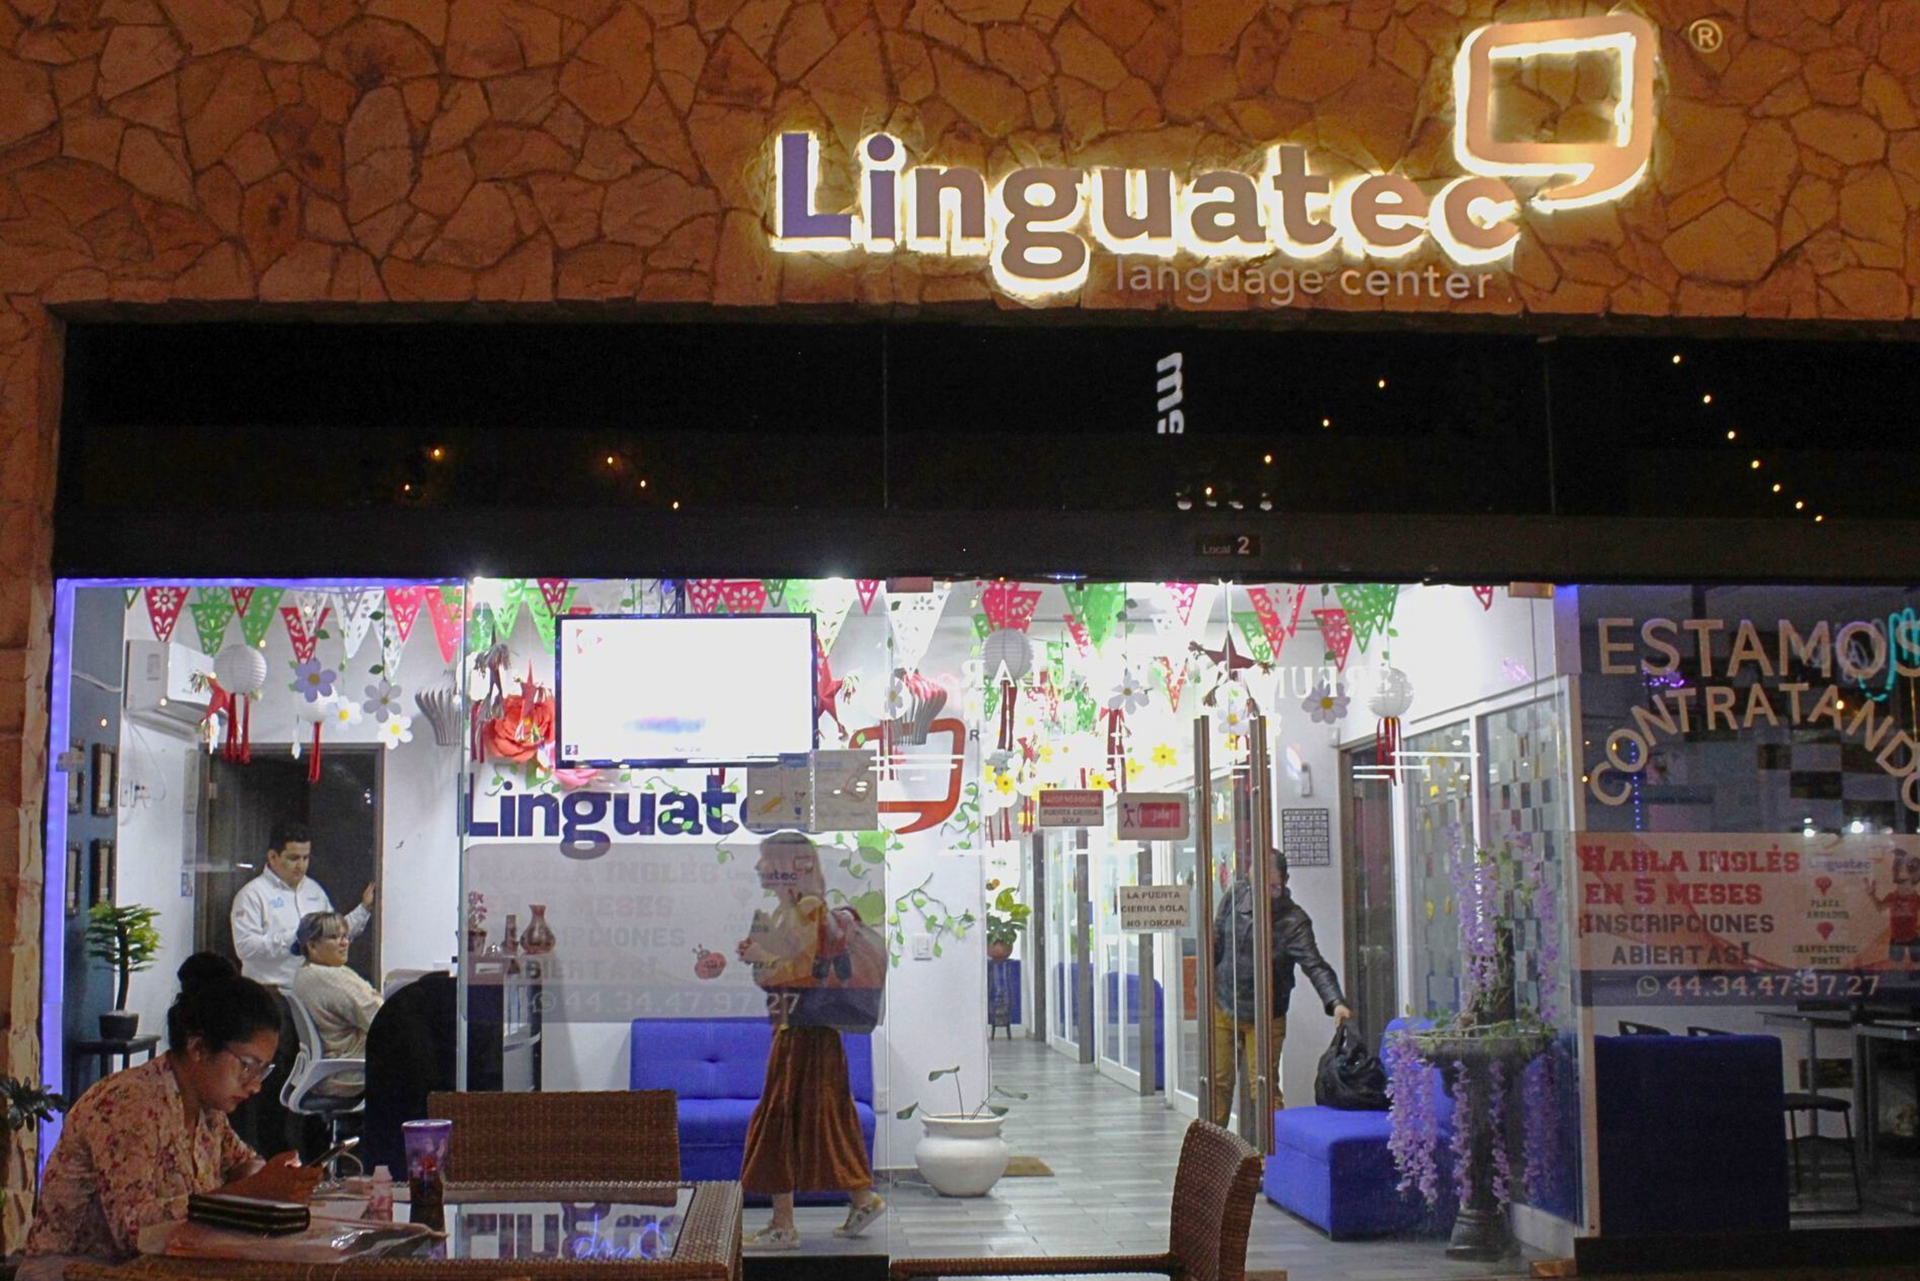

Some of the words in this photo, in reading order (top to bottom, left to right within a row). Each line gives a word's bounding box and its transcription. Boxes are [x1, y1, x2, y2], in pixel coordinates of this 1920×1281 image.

[780, 130, 1522, 281] Linguatec
[1117, 255, 1324, 306] language
[1340, 265, 1492, 299] center
[1237, 536, 1250, 555] 2
[1581, 845, 1688, 873] HABLA
[1698, 843, 1800, 873] INGLÉS
[1141, 891, 1181, 899] PUERTA
[1584, 882, 1625, 905] EN
[1634, 877, 1656, 905] 5
[1666, 882, 1763, 905] MESES
